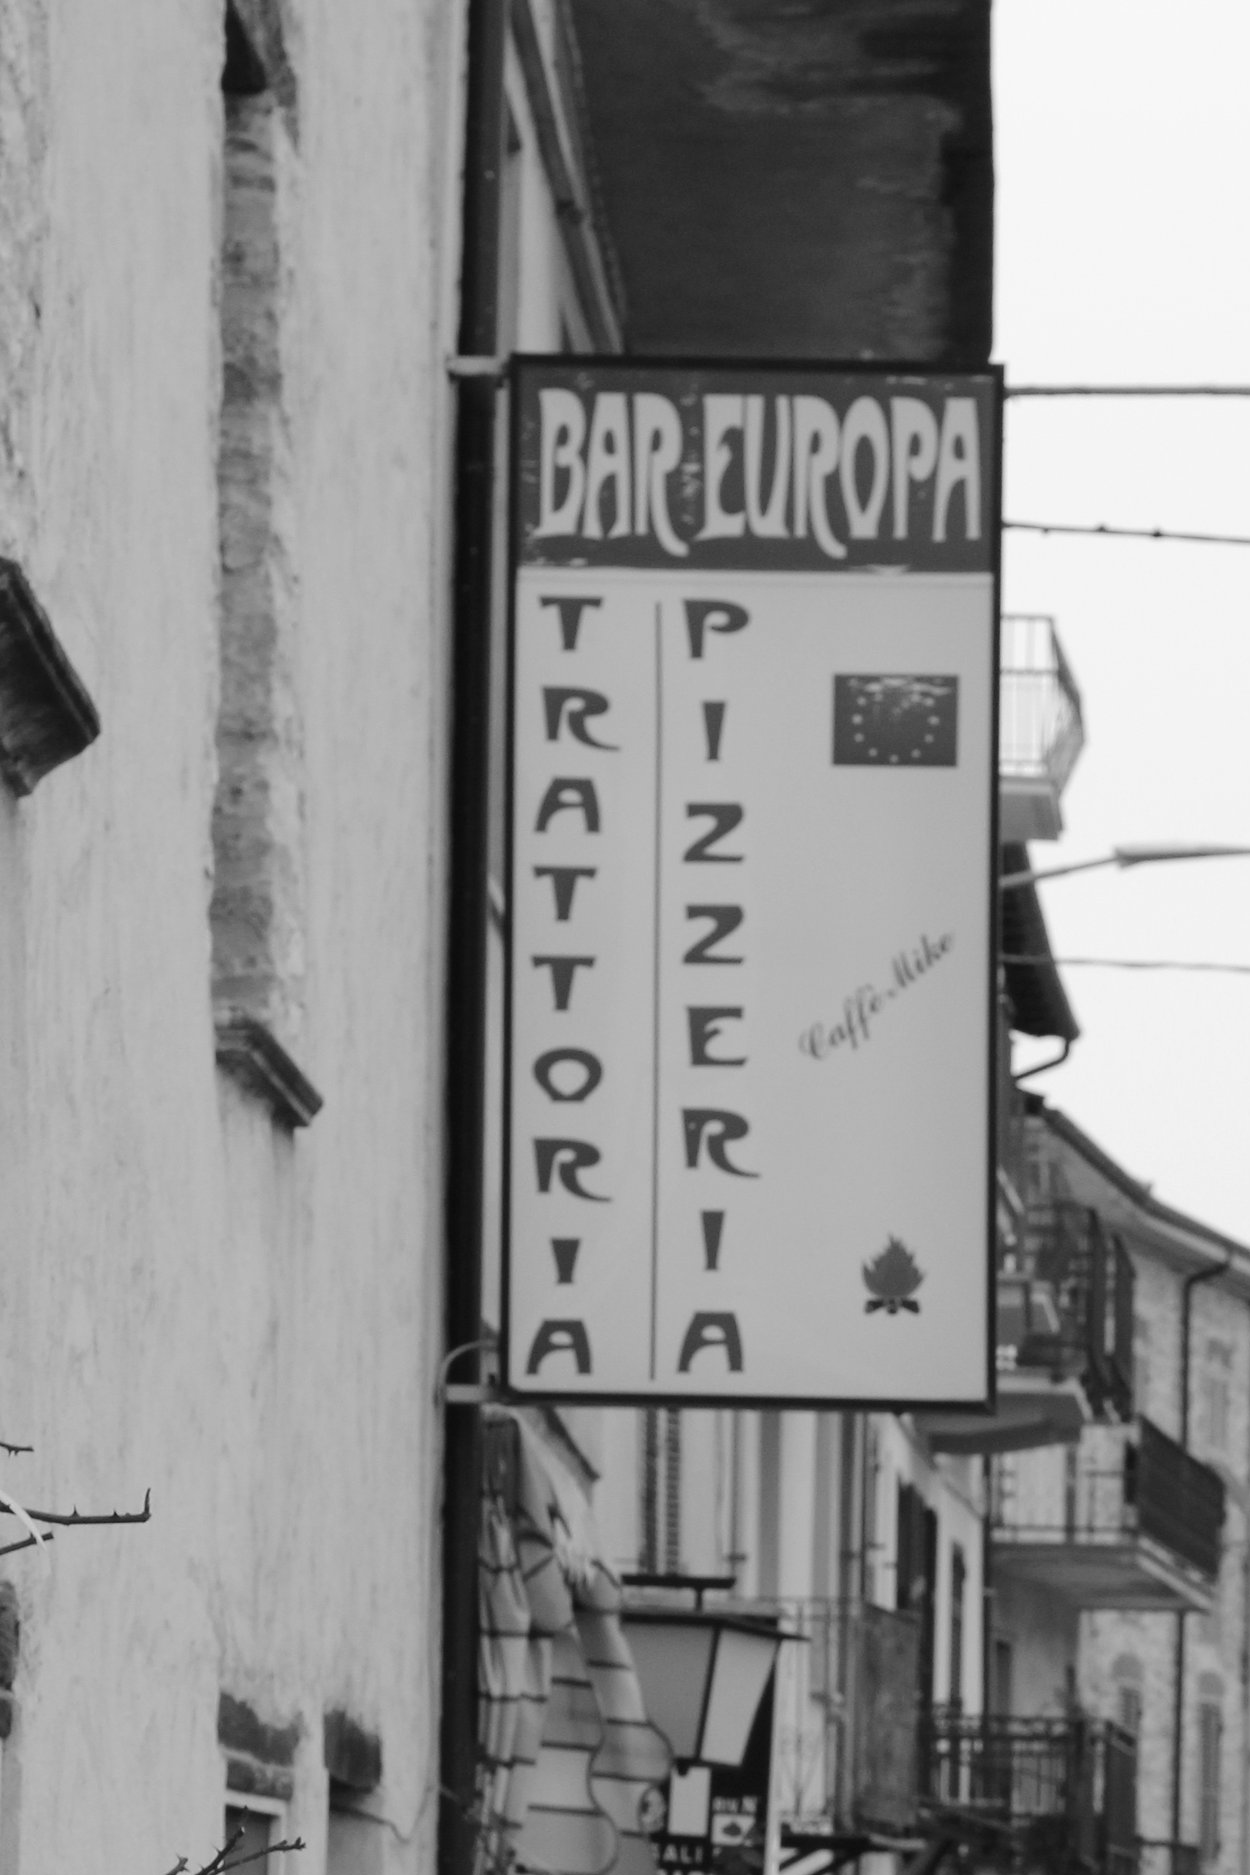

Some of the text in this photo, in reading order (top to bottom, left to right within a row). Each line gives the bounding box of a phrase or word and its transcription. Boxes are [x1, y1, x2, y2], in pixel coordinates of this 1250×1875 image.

[531, 388, 982, 560] BAR EUROPA
[524, 595, 621, 1376] TRATTORIA
[676, 598, 761, 1374] PIZZERIA
